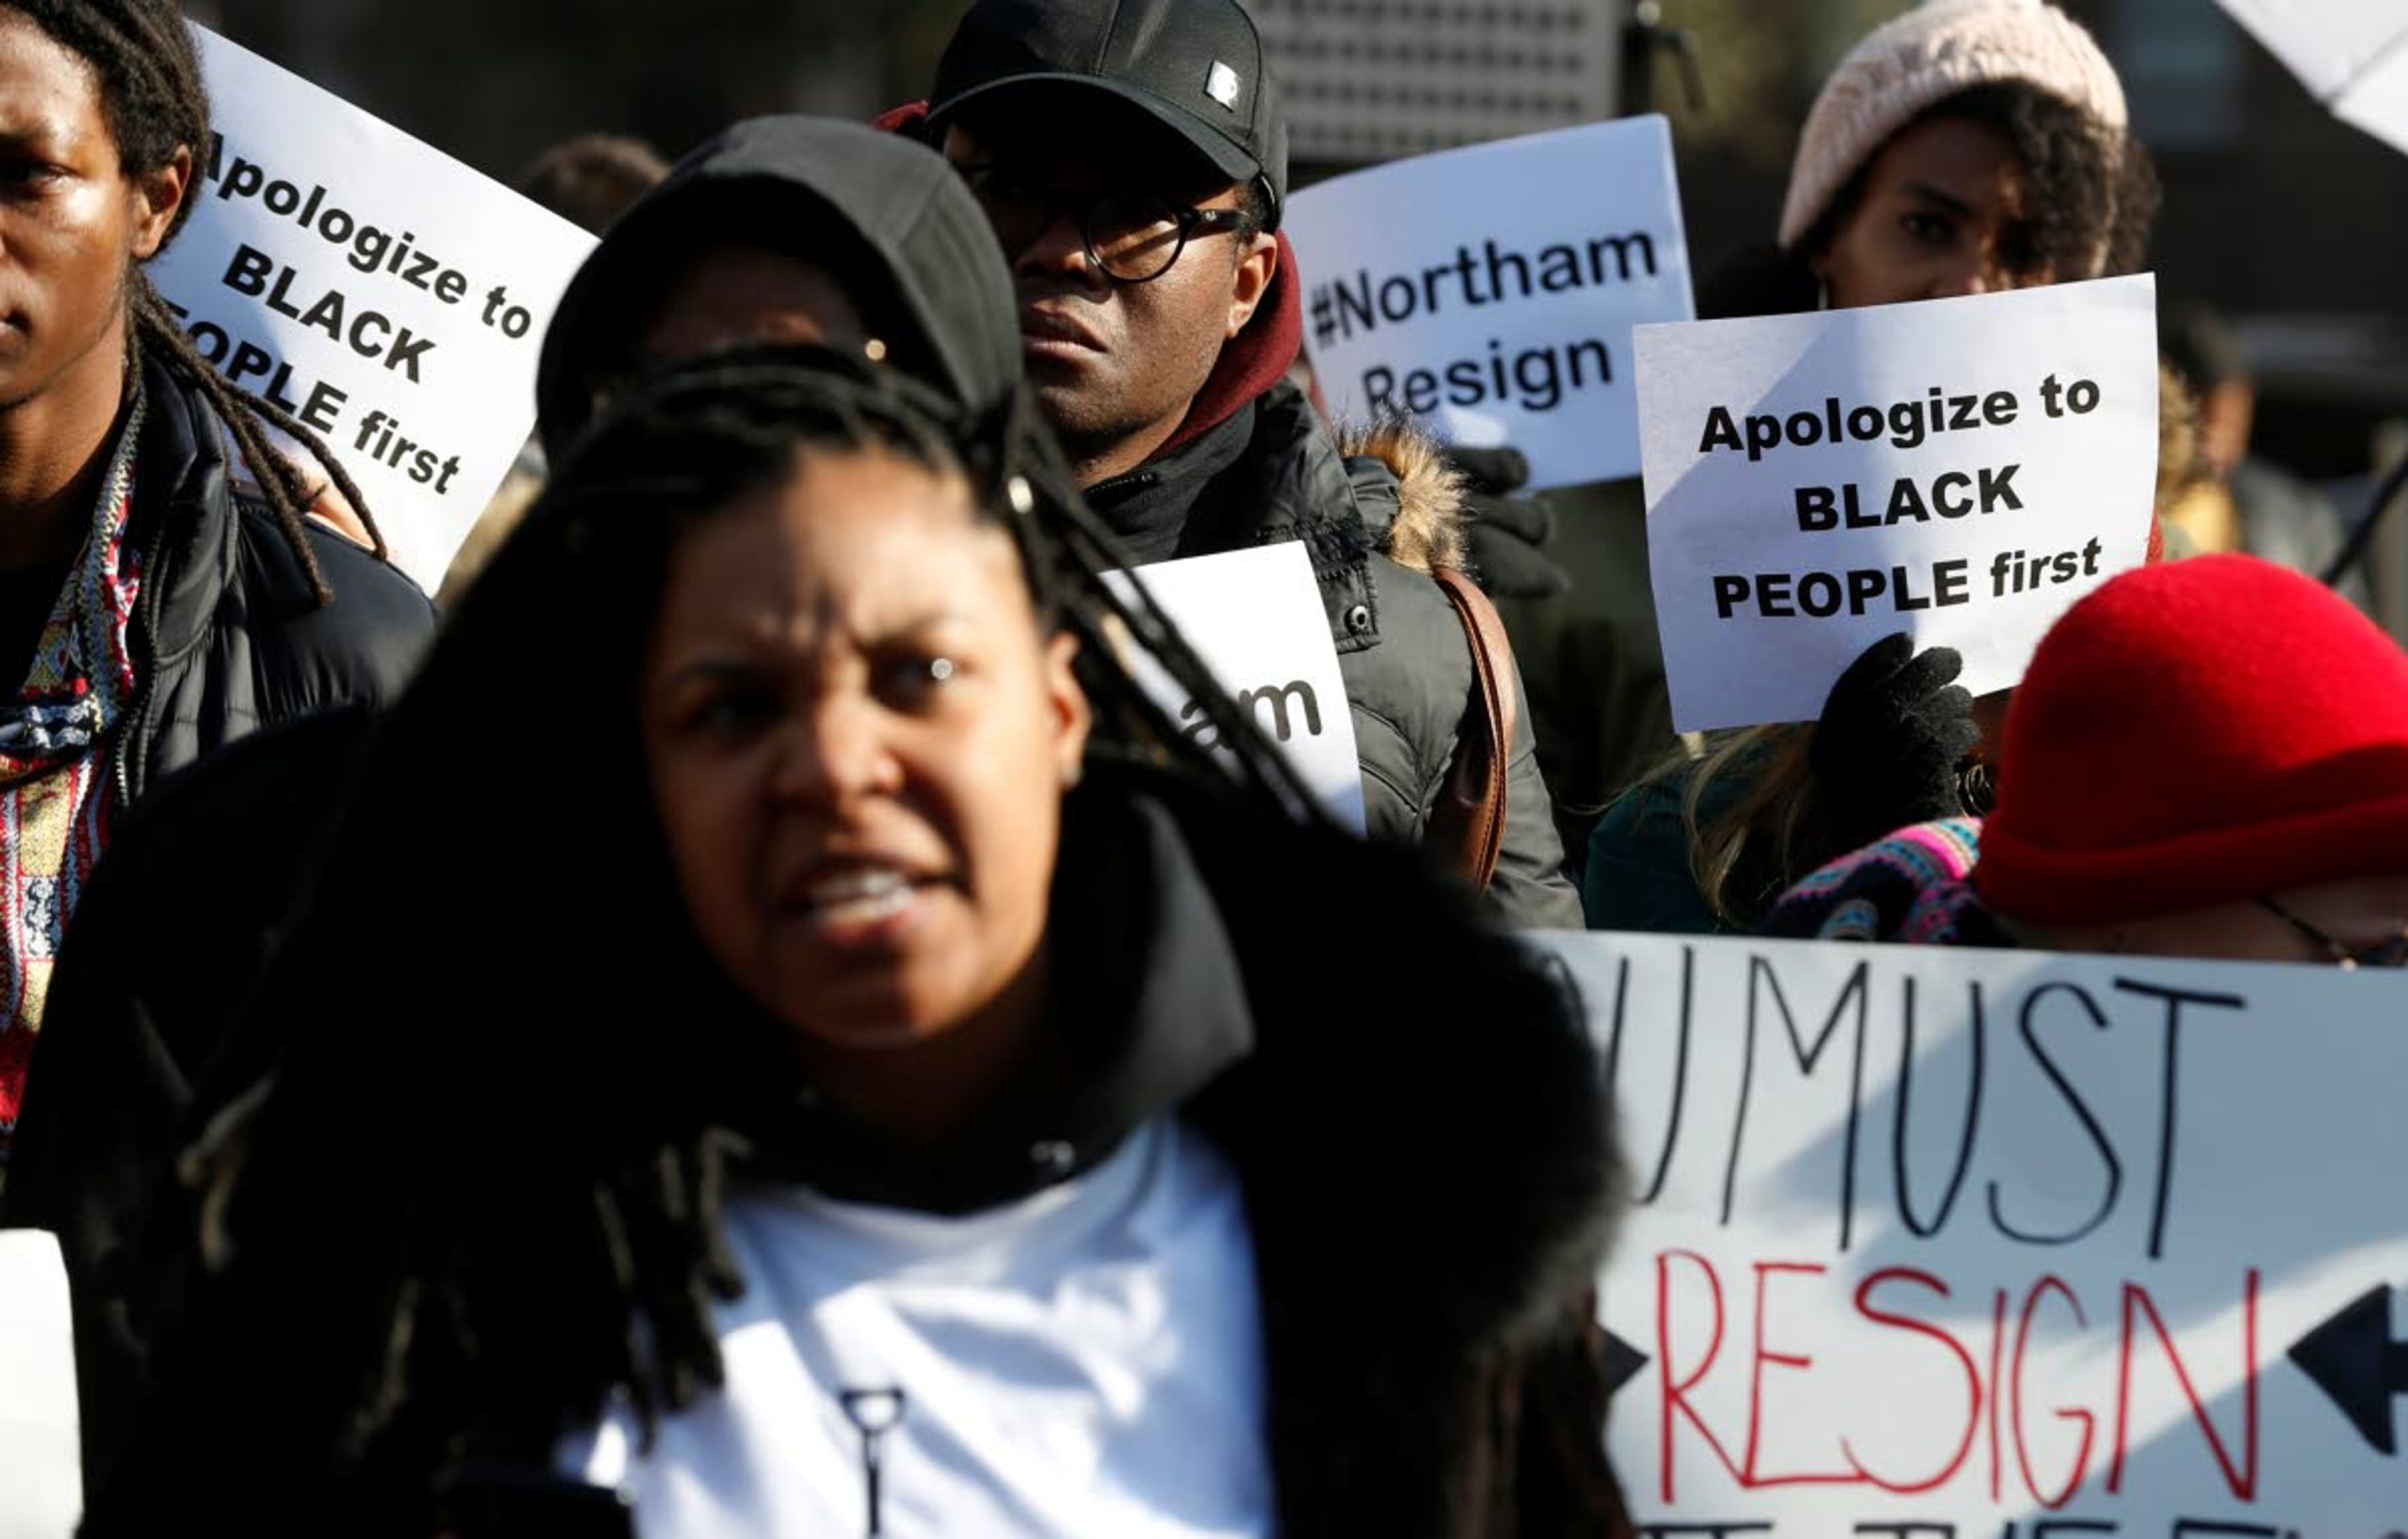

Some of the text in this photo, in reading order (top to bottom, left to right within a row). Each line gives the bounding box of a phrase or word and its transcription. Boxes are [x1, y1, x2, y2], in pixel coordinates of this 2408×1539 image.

[222, 243, 436, 384] BLACK
[480, 285, 531, 339] to
[1311, 230, 1657, 350] #Northam
[162, 297, 461, 495] OPLE first
[1363, 337, 1612, 420] Resign
[1699, 374, 2100, 461] Apologize to
[1795, 464, 2023, 531] BLACK
[1713, 536, 2102, 619] PEOPLE first
[1719, 953, 2246, 1261] MUST
[1657, 1248, 2261, 1510] RESIGN
